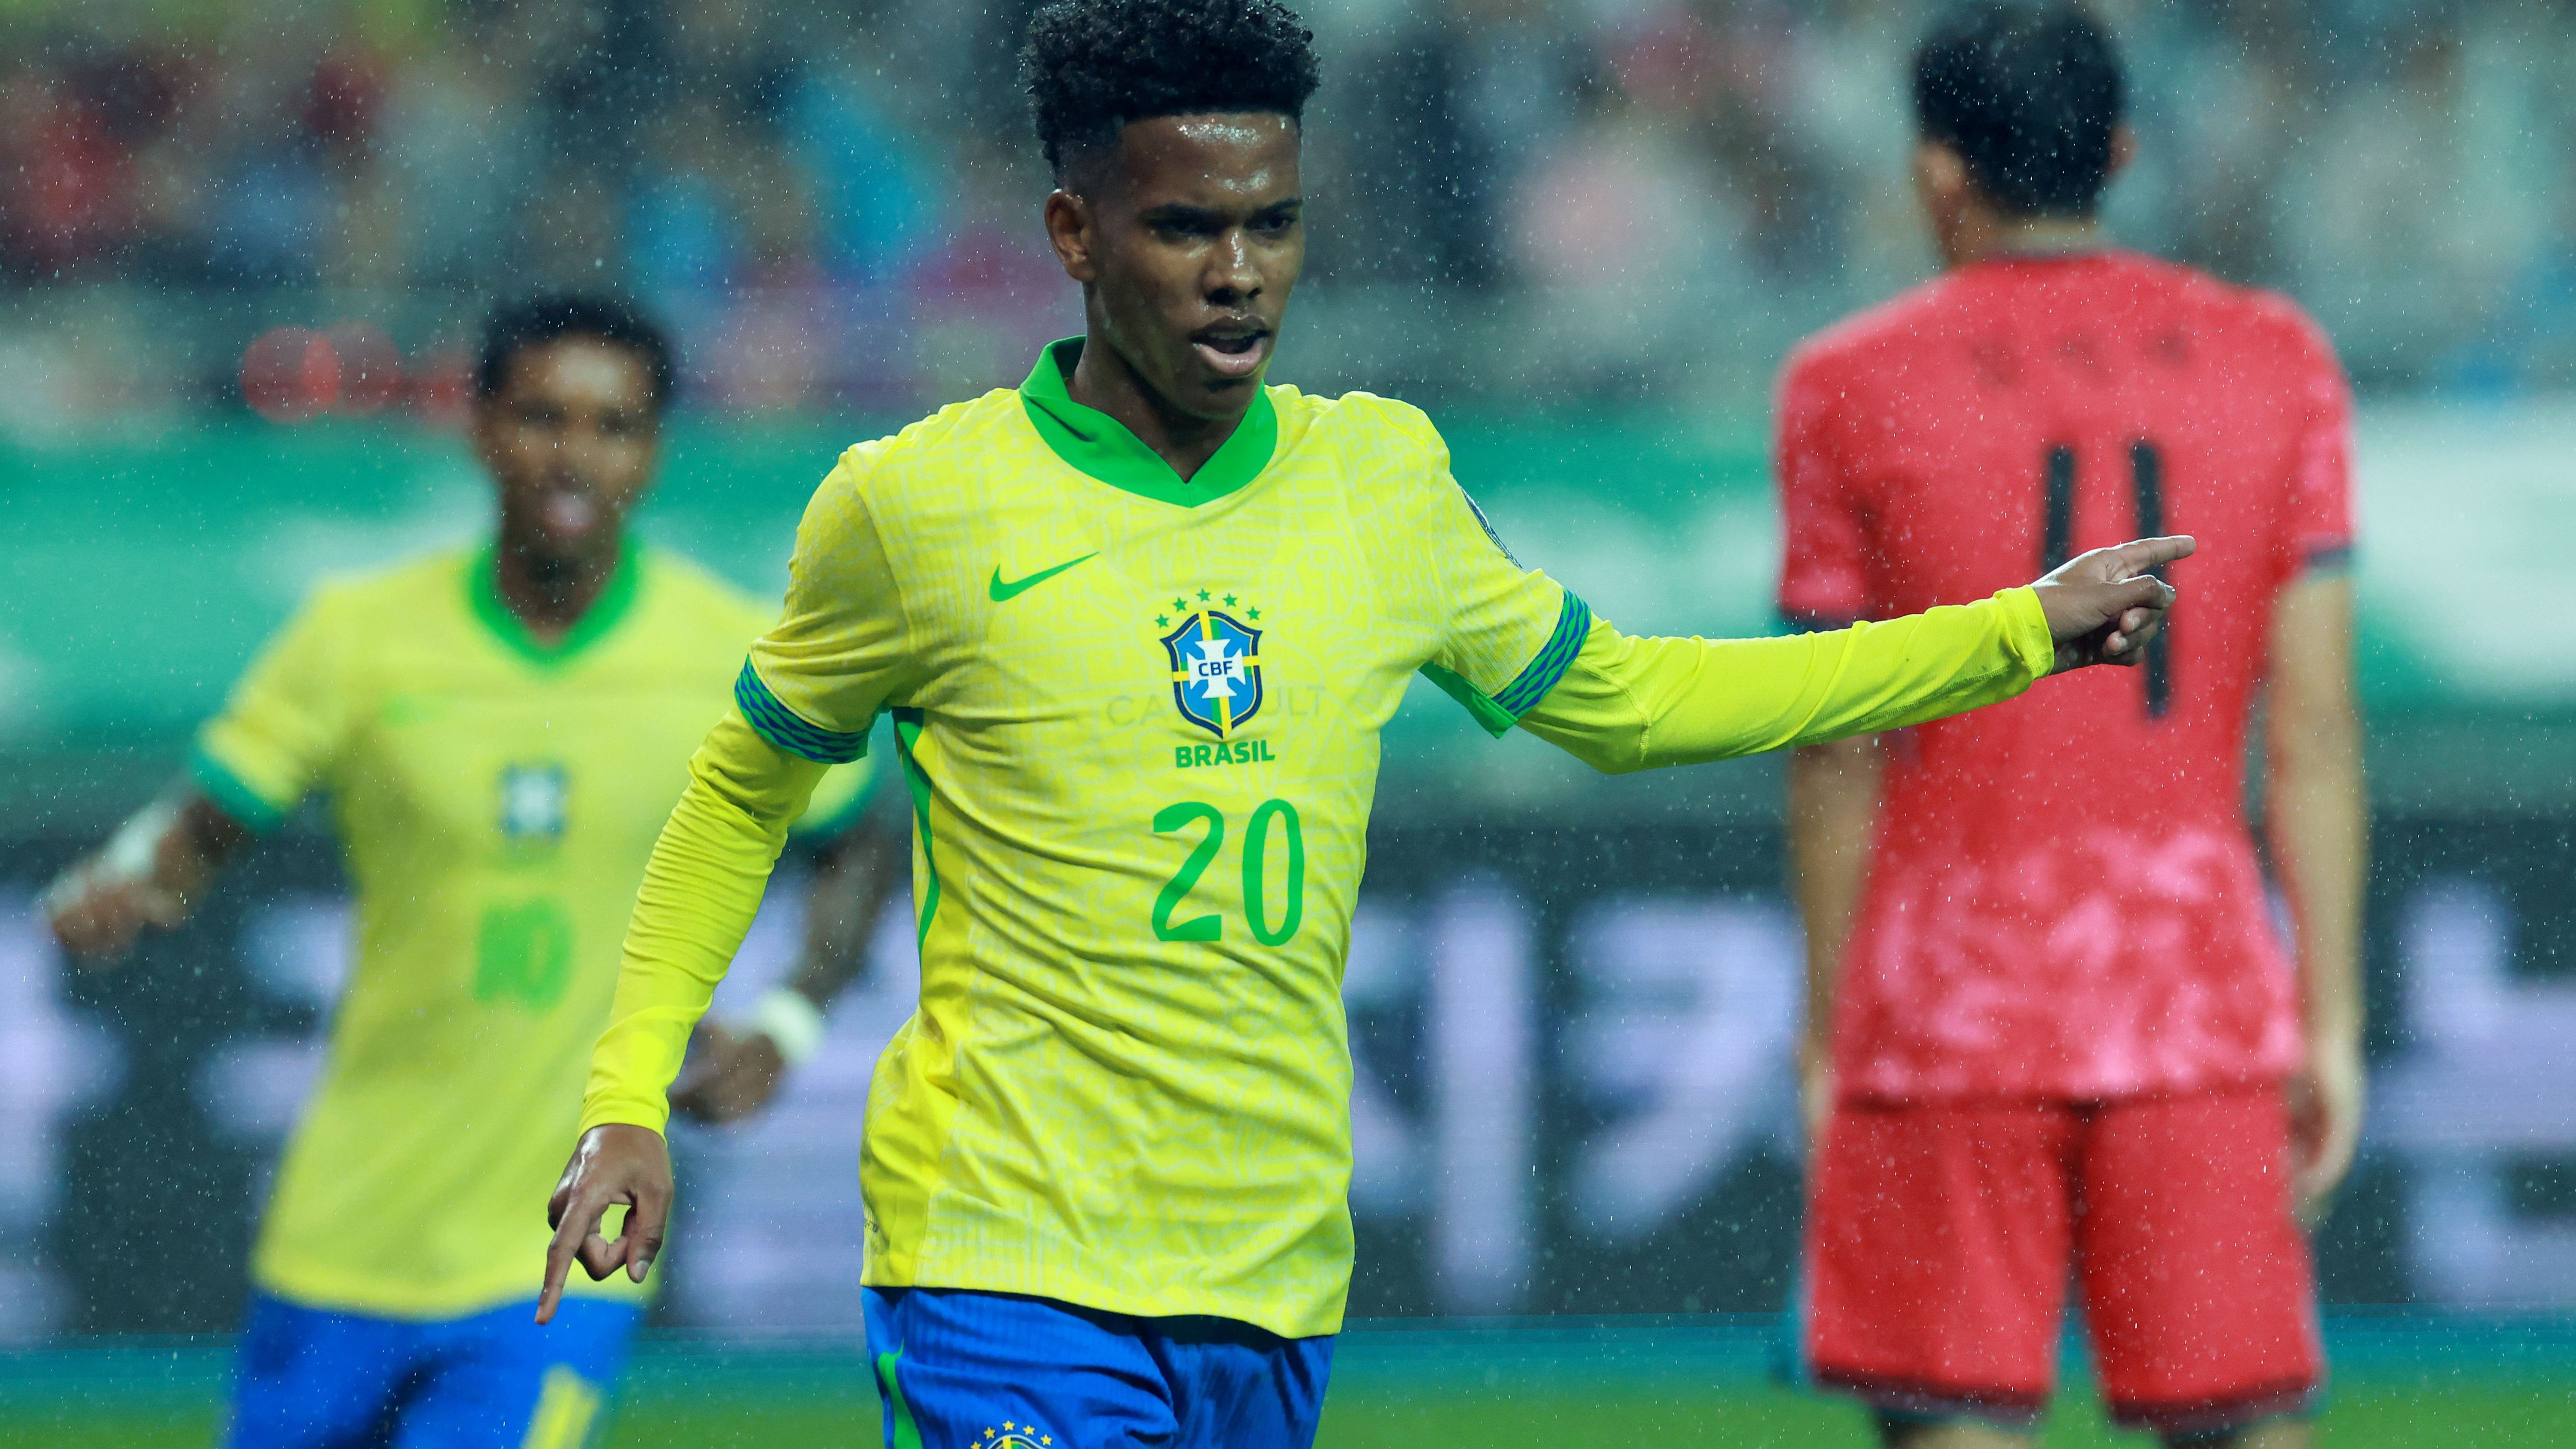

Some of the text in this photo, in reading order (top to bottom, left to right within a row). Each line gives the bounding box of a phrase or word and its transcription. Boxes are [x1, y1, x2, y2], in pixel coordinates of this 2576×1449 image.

[1198, 660, 1233, 677] CBF
[1105, 684, 1327, 727] CAULT
[1175, 739, 1276, 769] BRASIL
[1151, 798, 1305, 947] 20
[474, 897, 576, 1019] 10
